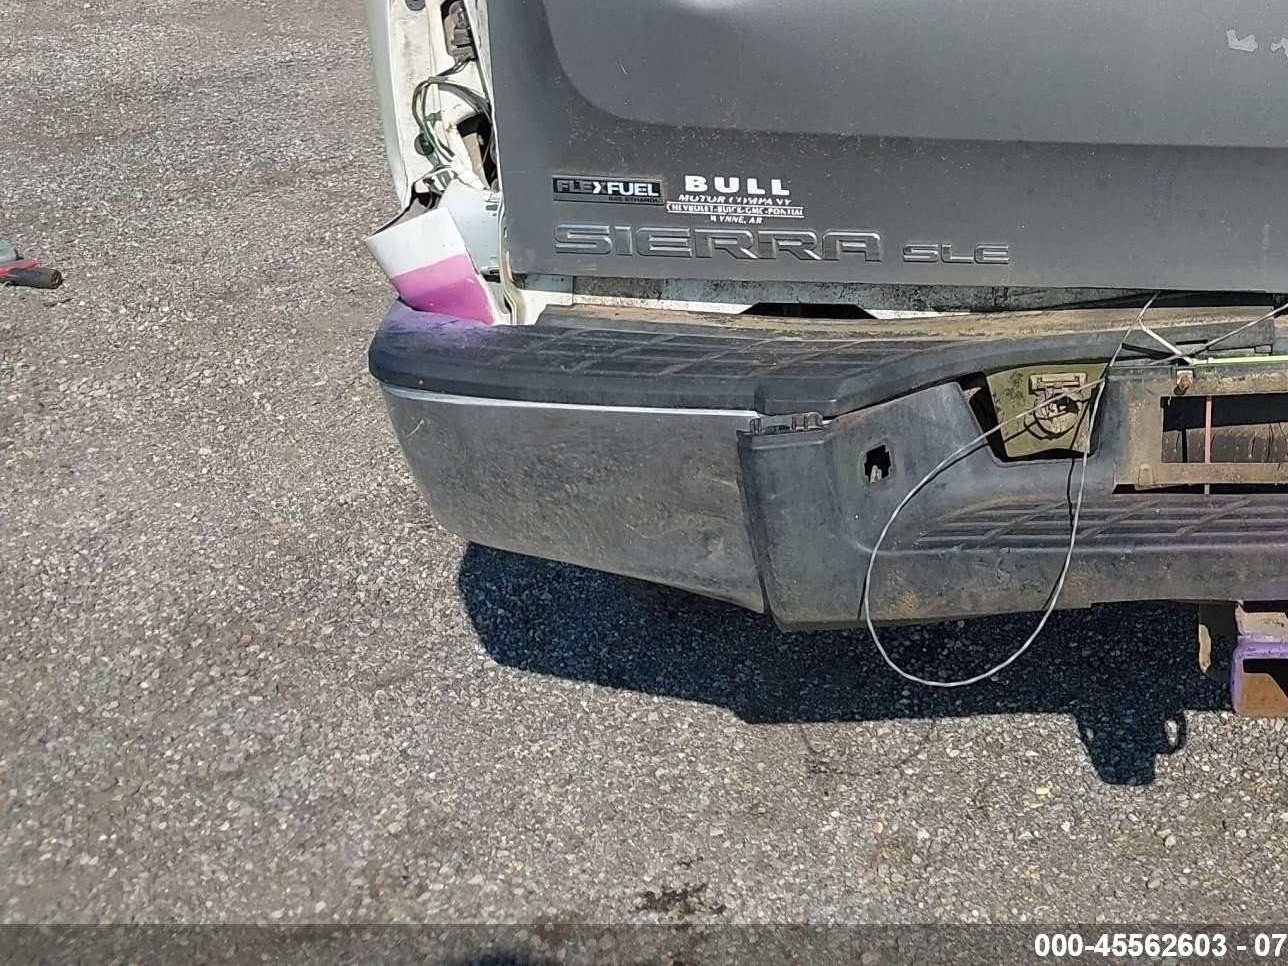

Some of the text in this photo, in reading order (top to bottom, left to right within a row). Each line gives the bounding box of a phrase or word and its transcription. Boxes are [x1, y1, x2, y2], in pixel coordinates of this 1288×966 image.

[685, 175, 790, 196] BULL
[678, 194, 725, 204] MOTOR
[748, 216, 763, 224] AR
[554, 224, 1010, 266] SIERRA SLE
